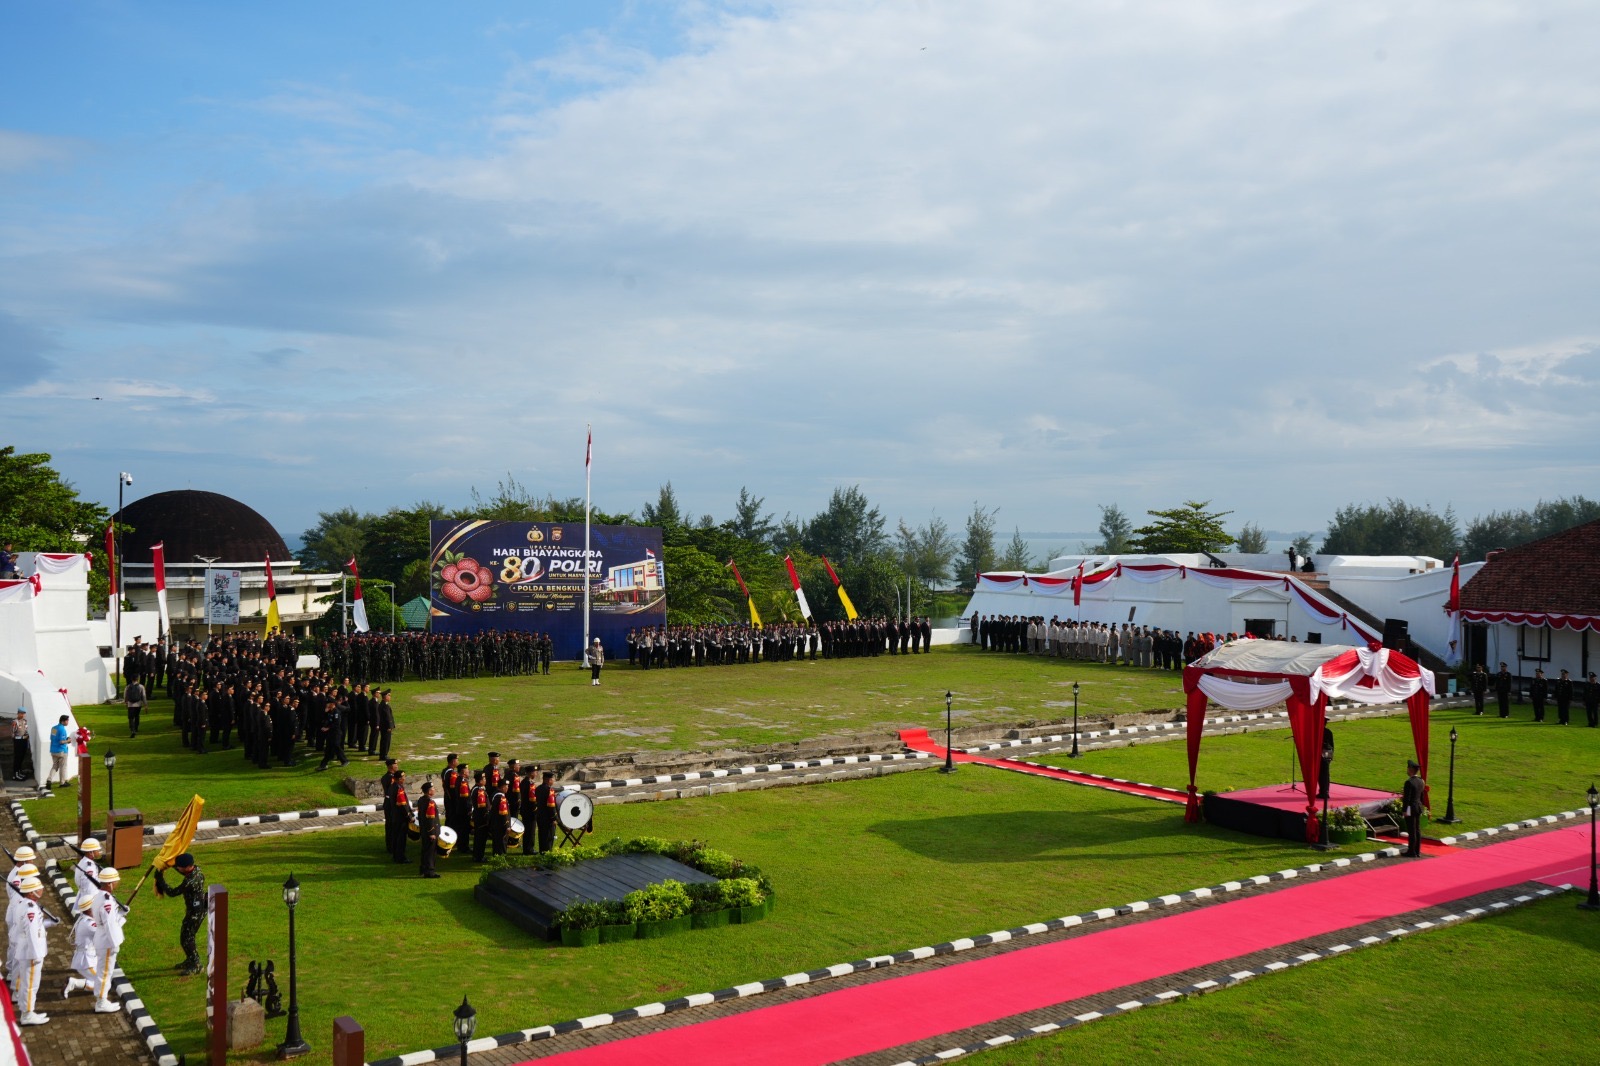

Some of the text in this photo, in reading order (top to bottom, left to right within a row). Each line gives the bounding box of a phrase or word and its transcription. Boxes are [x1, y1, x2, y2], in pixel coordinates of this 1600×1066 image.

[493, 548, 520, 557] HARI
[500, 556, 541, 583] 80
[549, 560, 603, 573] POLRI
